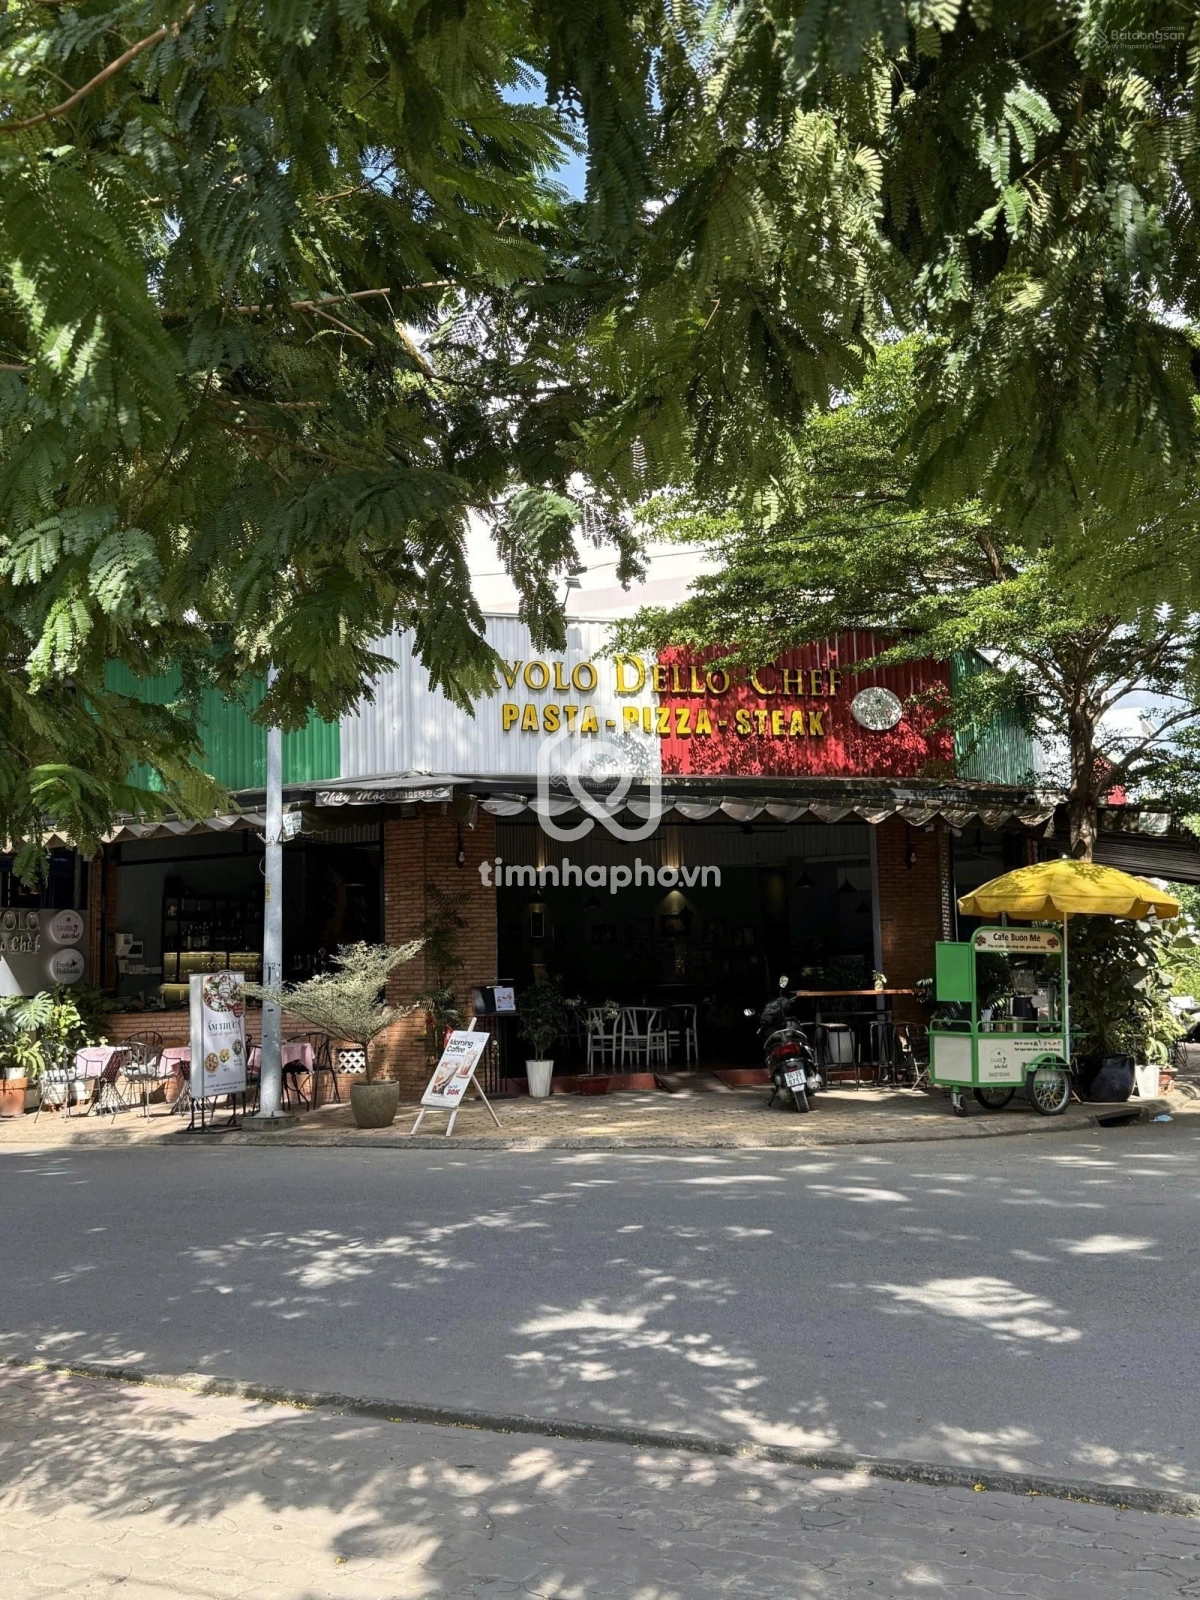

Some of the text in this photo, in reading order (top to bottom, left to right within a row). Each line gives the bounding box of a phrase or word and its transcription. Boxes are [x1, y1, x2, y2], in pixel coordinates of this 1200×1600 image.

[502, 703, 599, 733] PASTA
[622, 706, 712, 735] PIZZA
[735, 708, 825, 736] STEAK
[450, 1039, 474, 1049] Morning
